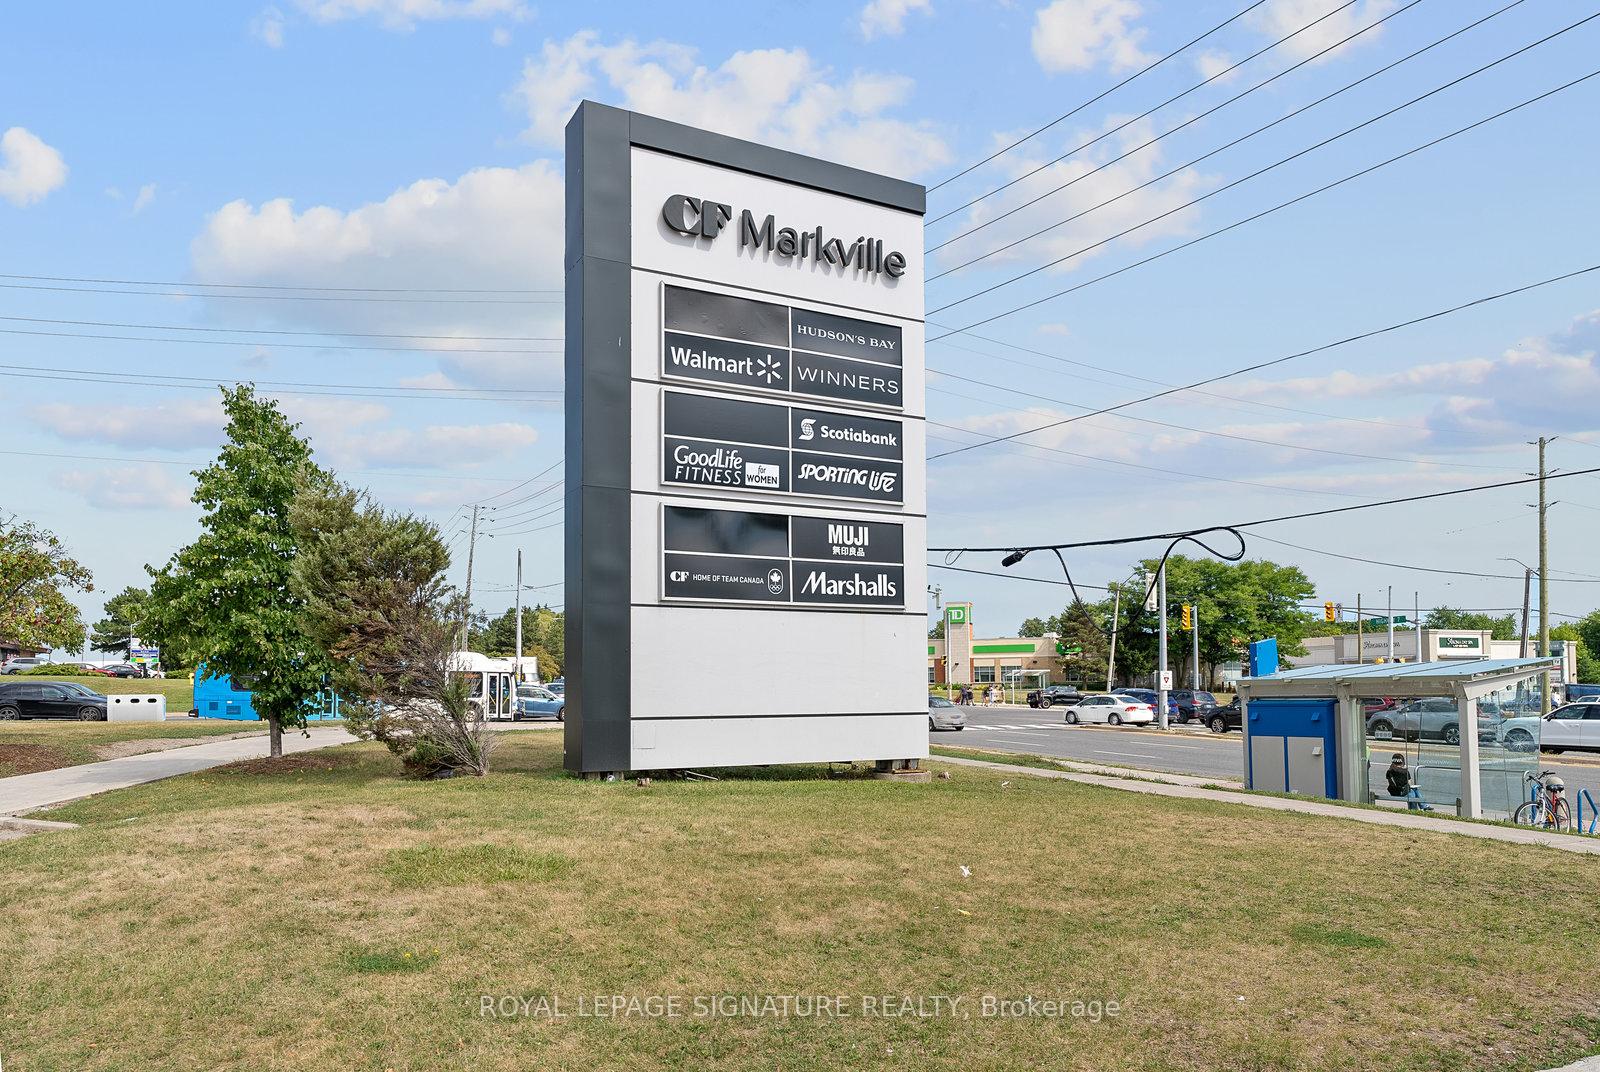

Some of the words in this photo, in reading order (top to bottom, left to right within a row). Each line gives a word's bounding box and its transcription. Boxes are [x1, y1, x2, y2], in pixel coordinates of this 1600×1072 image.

[661, 193, 732, 240] CF
[741, 208, 907, 278] Markville
[796, 324, 866, 346] HUDSON'S
[869, 338, 896, 350] BAY
[670, 346, 753, 376] Walmart
[797, 366, 899, 395] WINNERS
[820, 425, 898, 447] Scotiabank
[673, 444, 743, 470] GoodLife
[675, 465, 742, 485] FITNESS
[746, 474, 778, 485] WOMEN
[757, 465, 767, 475] for
[828, 524, 869, 546] MUJI
[832, 545, 866, 557] 無印良品
[669, 570, 690, 582] CF
[693, 574, 712, 582] HOME
[721, 575, 739, 583] TEAM
[739, 576, 765, 585] CANADA
[800, 571, 897, 597] Marshalls
[948, 609, 964, 620] TD
